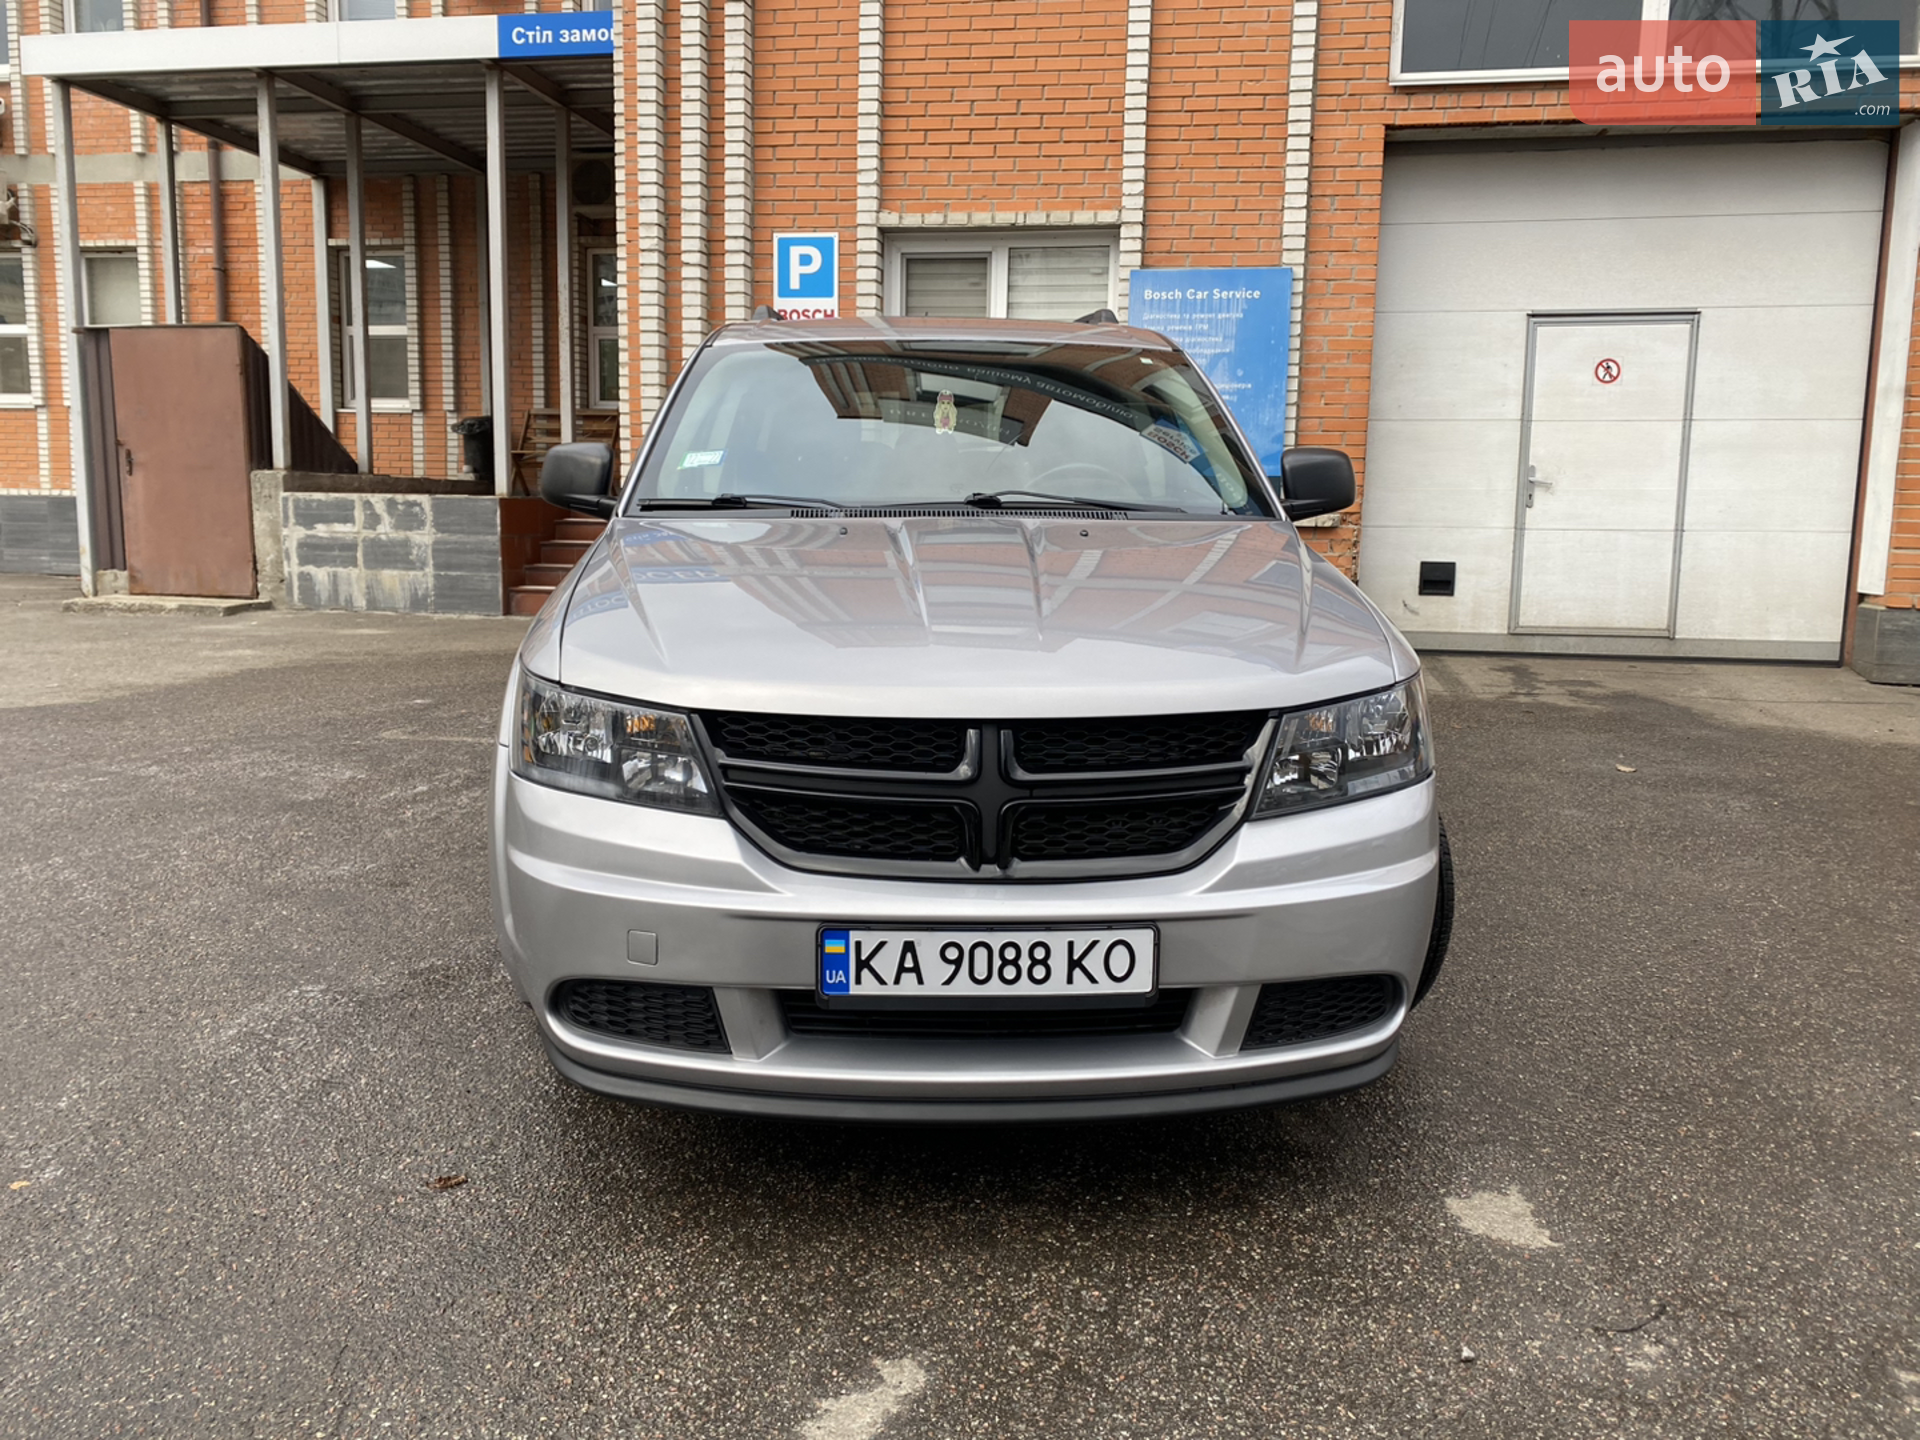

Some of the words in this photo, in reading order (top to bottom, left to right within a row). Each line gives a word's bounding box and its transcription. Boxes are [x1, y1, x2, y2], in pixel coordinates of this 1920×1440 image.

[511, 25, 553, 45] Стіл
[558, 27, 614, 43] замо
[789, 245, 823, 290] P
[1144, 289, 1182, 300] Bosch
[1186, 288, 1209, 300] Car
[1212, 287, 1261, 299] Service
[854, 940, 925, 986] KA
[939, 940, 1052, 986] 9088
[1066, 938, 1136, 985] KO
[826, 970, 847, 984] UA
